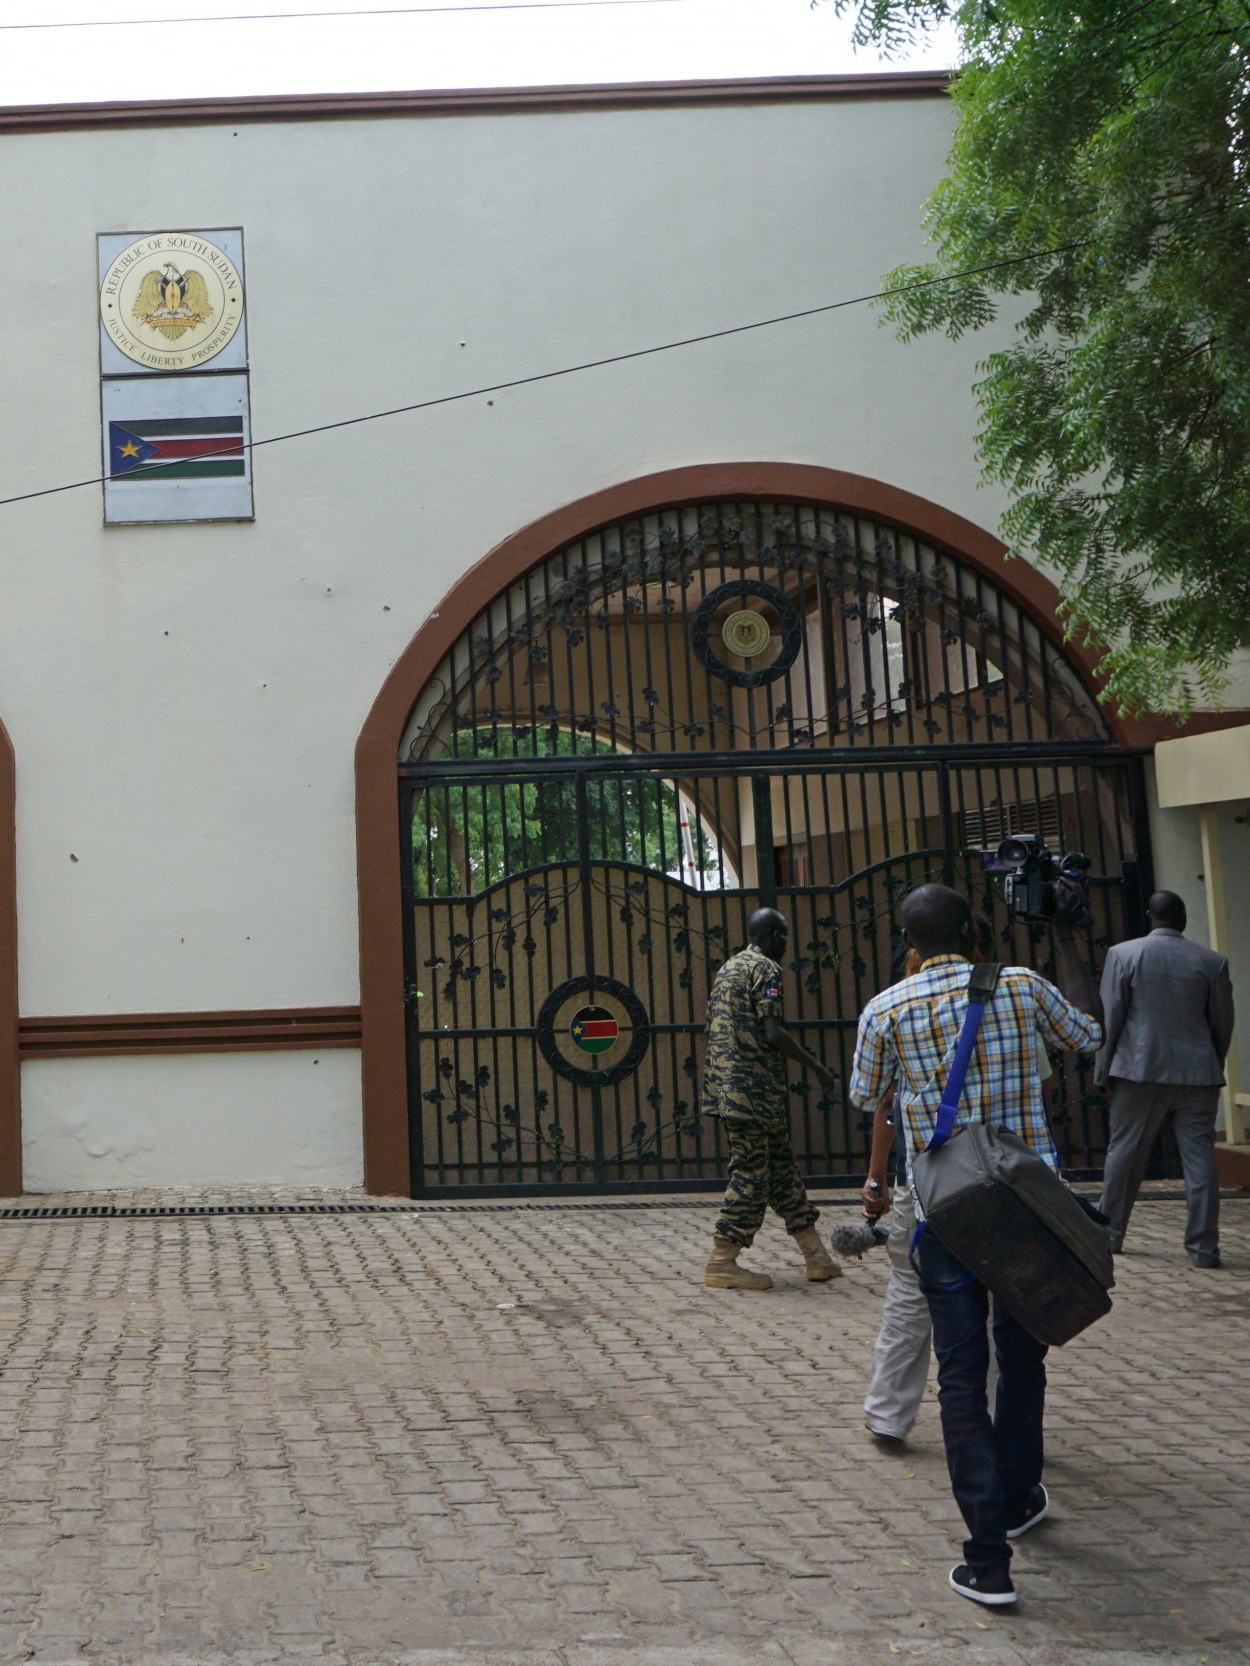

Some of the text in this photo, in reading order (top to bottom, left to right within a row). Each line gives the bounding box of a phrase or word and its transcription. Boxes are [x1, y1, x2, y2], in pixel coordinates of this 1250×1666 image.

[105, 237, 237, 295] REPUBLIC OF SOUTH SUDAN
[108, 313, 236, 365] JUSTICE LIBERTY PROSPERITY
